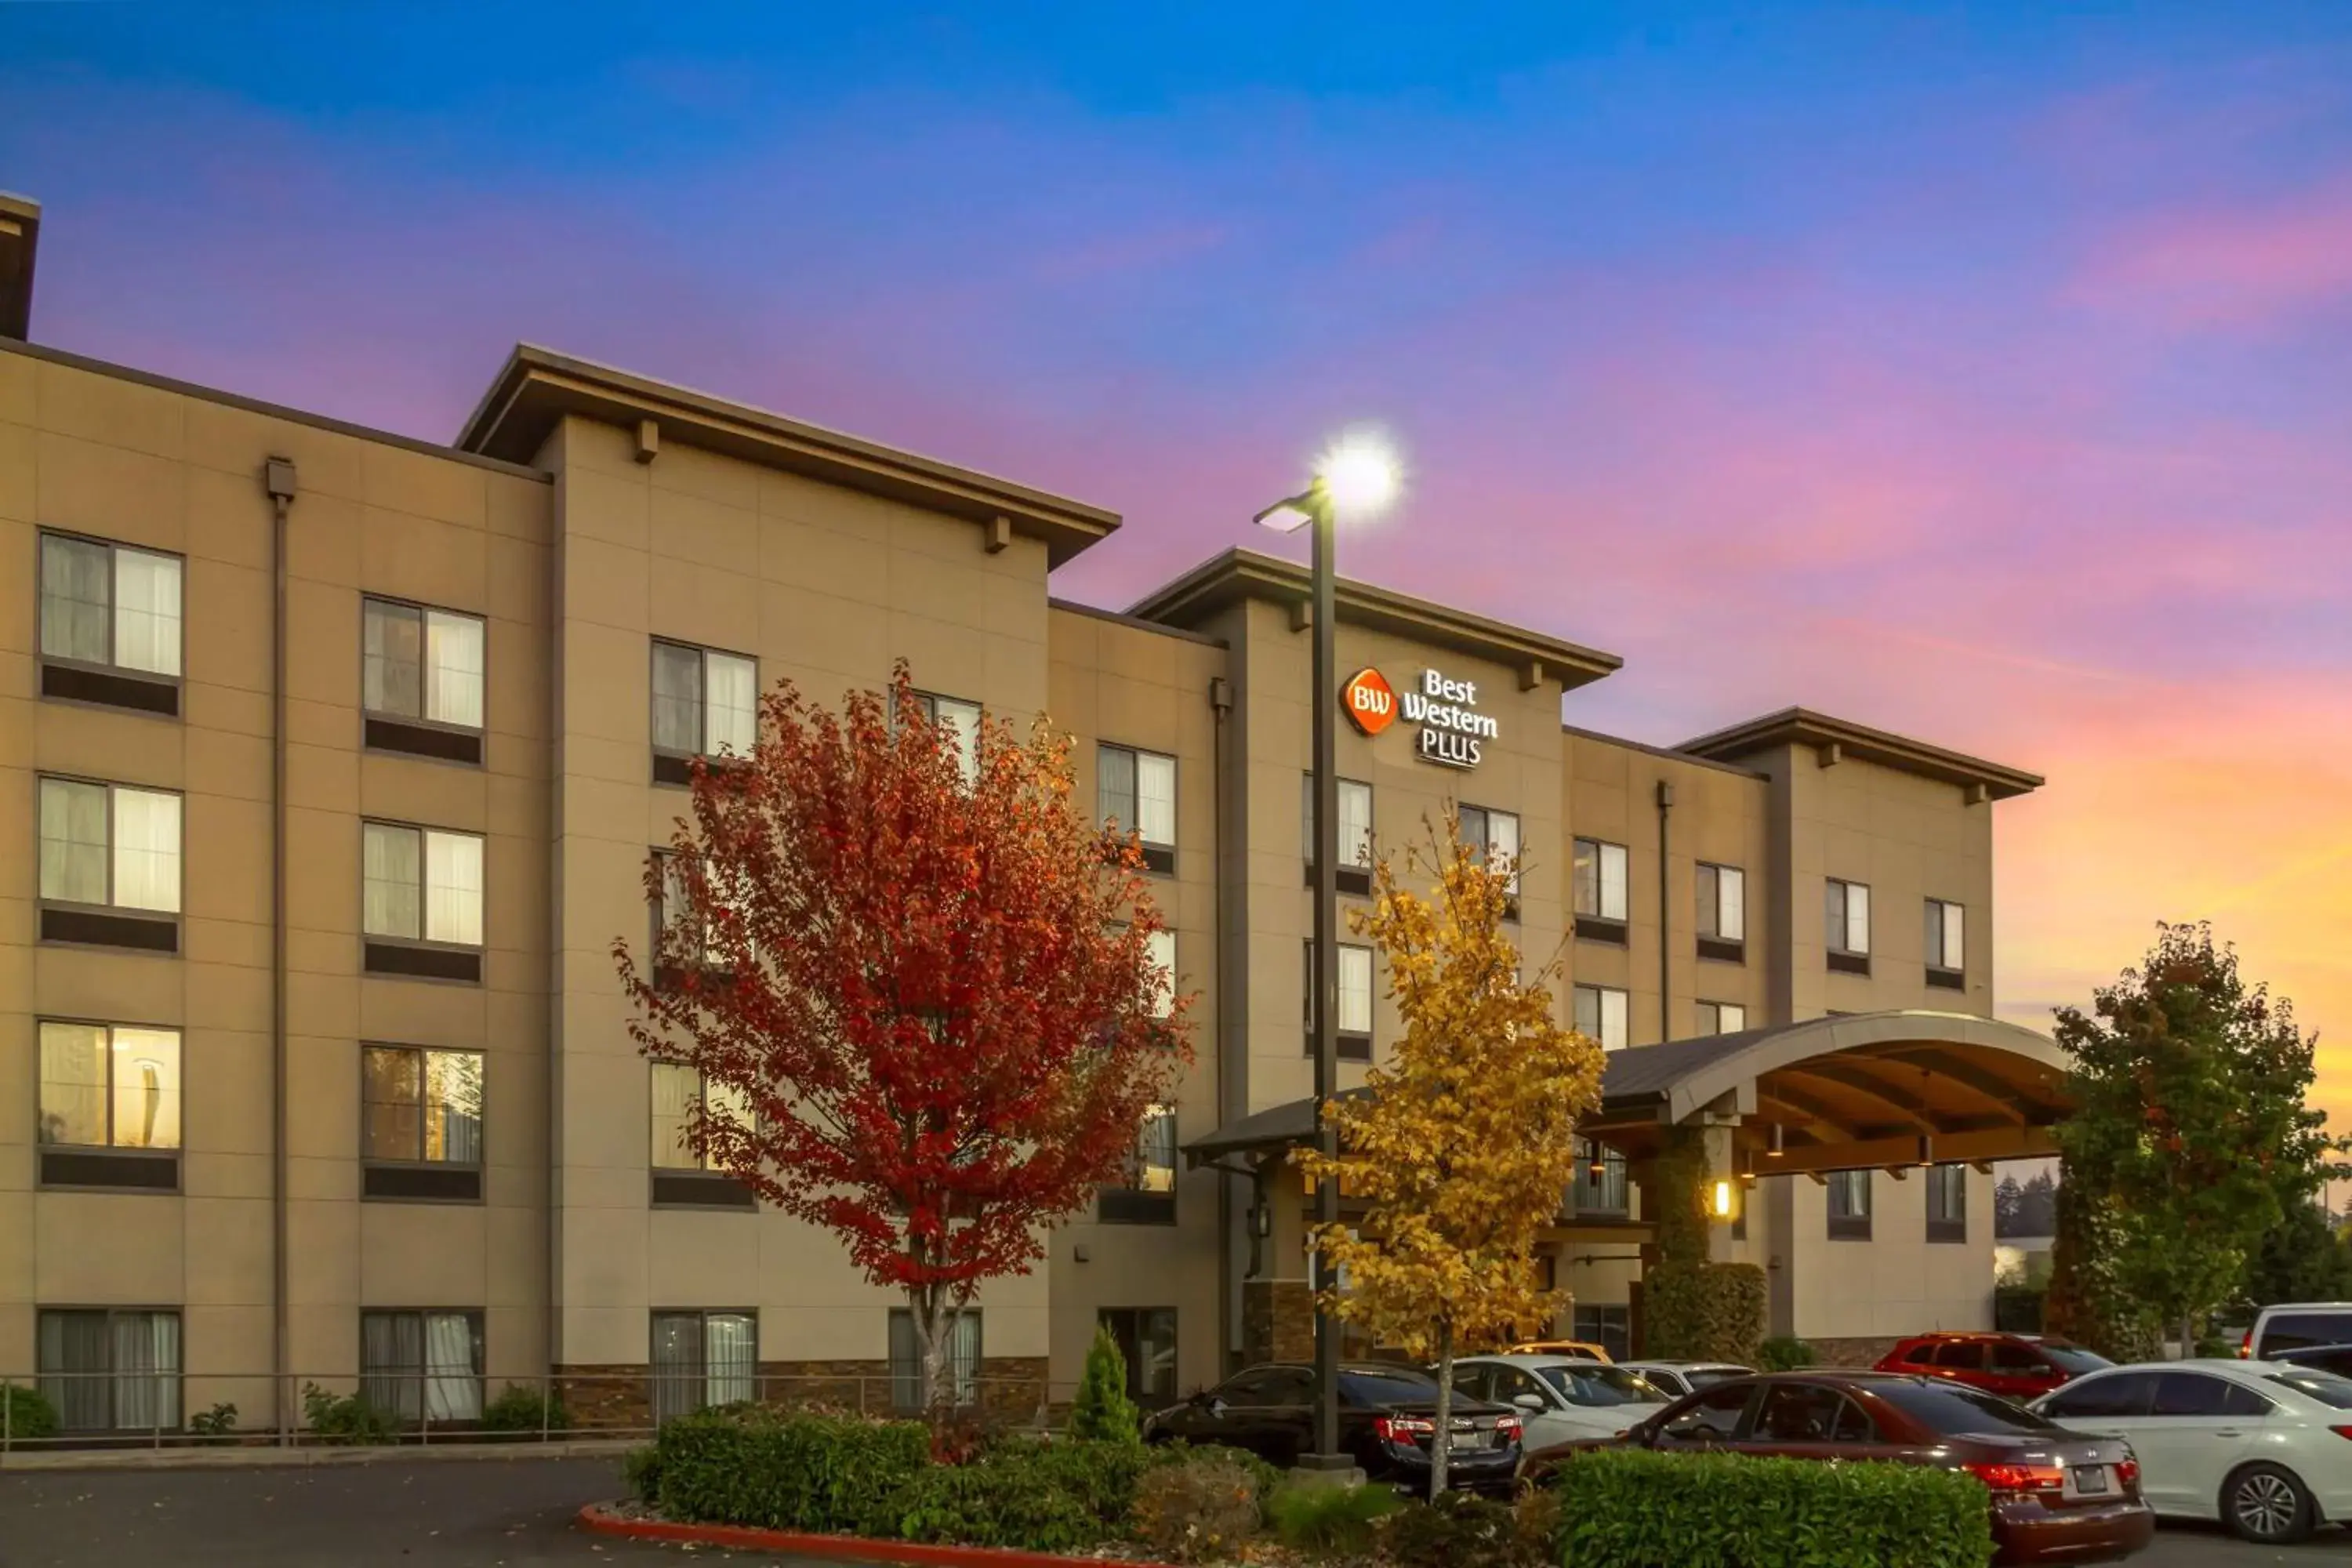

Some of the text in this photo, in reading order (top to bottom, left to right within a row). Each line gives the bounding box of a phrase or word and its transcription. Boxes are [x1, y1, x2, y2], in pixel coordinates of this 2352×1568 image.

[1354, 686, 1390, 714] BW
[1426, 669, 1476, 705] Best
[1404, 692, 1498, 739] Western
[1422, 728, 1481, 764] PLUS
